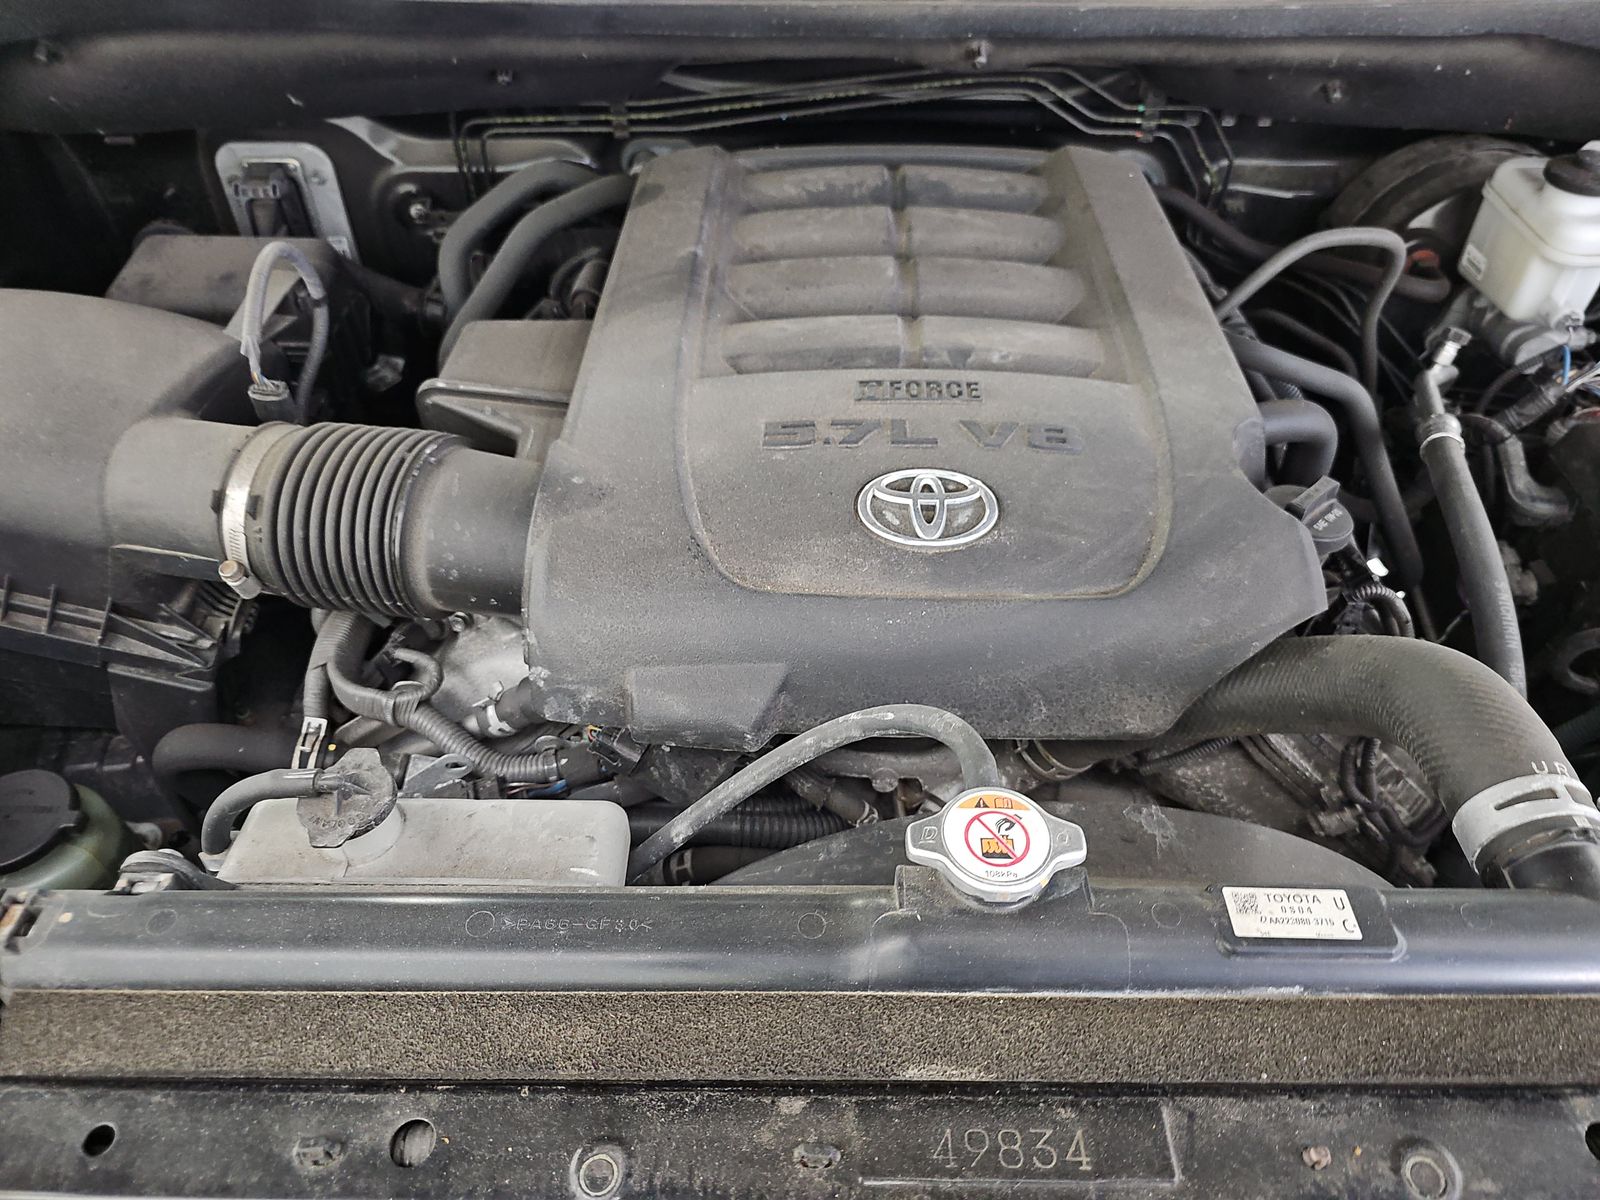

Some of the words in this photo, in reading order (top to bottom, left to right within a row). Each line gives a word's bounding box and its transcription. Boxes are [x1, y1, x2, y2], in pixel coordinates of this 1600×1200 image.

[959, 420, 1081, 452] V8
[1265, 892, 1321, 904] TOYOTA
[1333, 896, 1346, 911] U
[931, 1128, 1093, 1171] 49834
